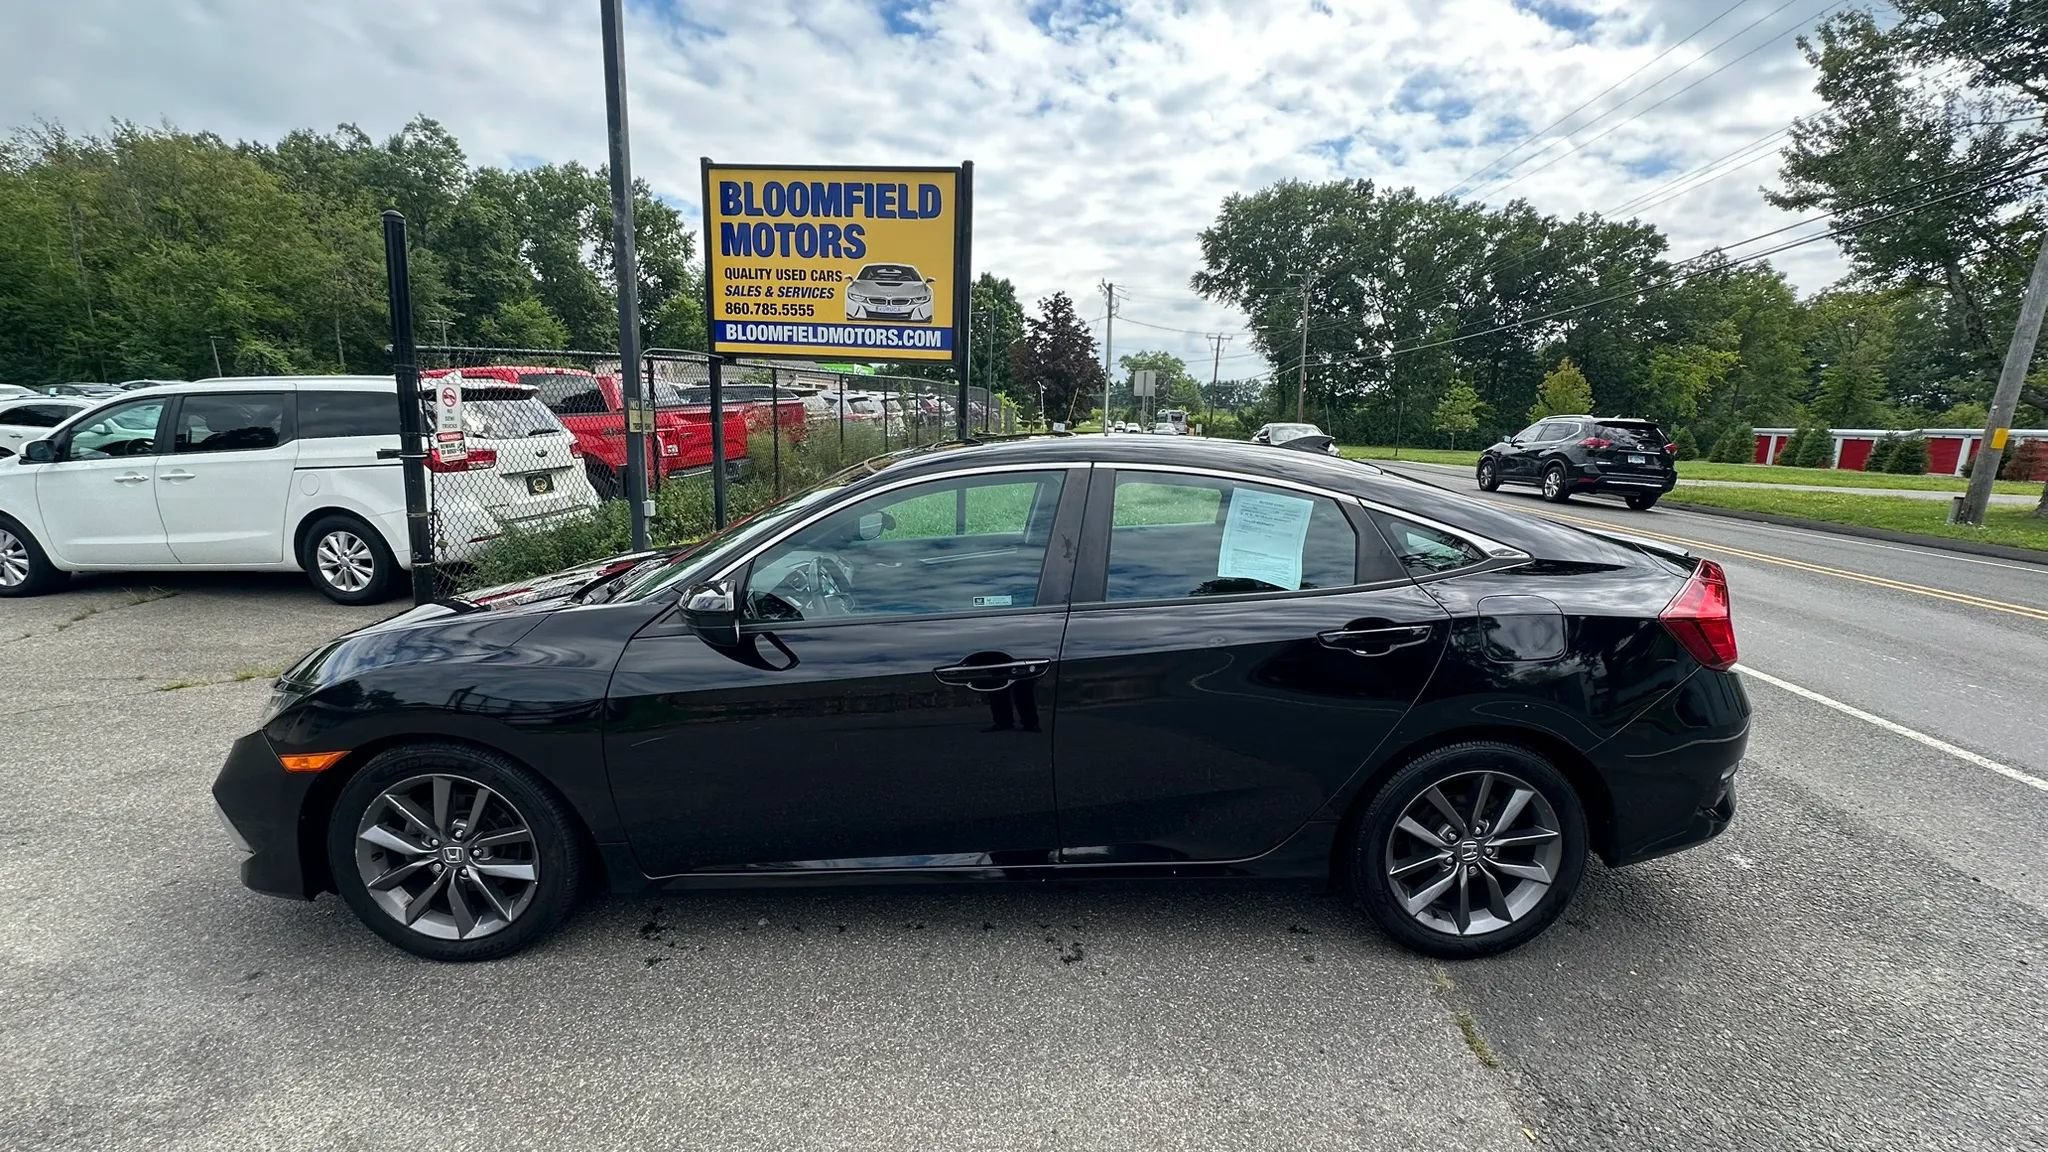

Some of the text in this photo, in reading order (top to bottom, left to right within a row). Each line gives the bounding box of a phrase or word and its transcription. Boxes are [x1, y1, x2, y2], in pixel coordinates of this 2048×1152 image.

[720, 181, 942, 219] BLOOMFIELD
[721, 222, 866, 259] MOTORS
[724, 267, 842, 282] QUALITY USED CARS
[725, 285, 835, 299] SALES & SERVICES
[725, 302, 814, 316] 860.785.5555
[725, 323, 941, 347] BLOOMFIELDMOTORS.COM
